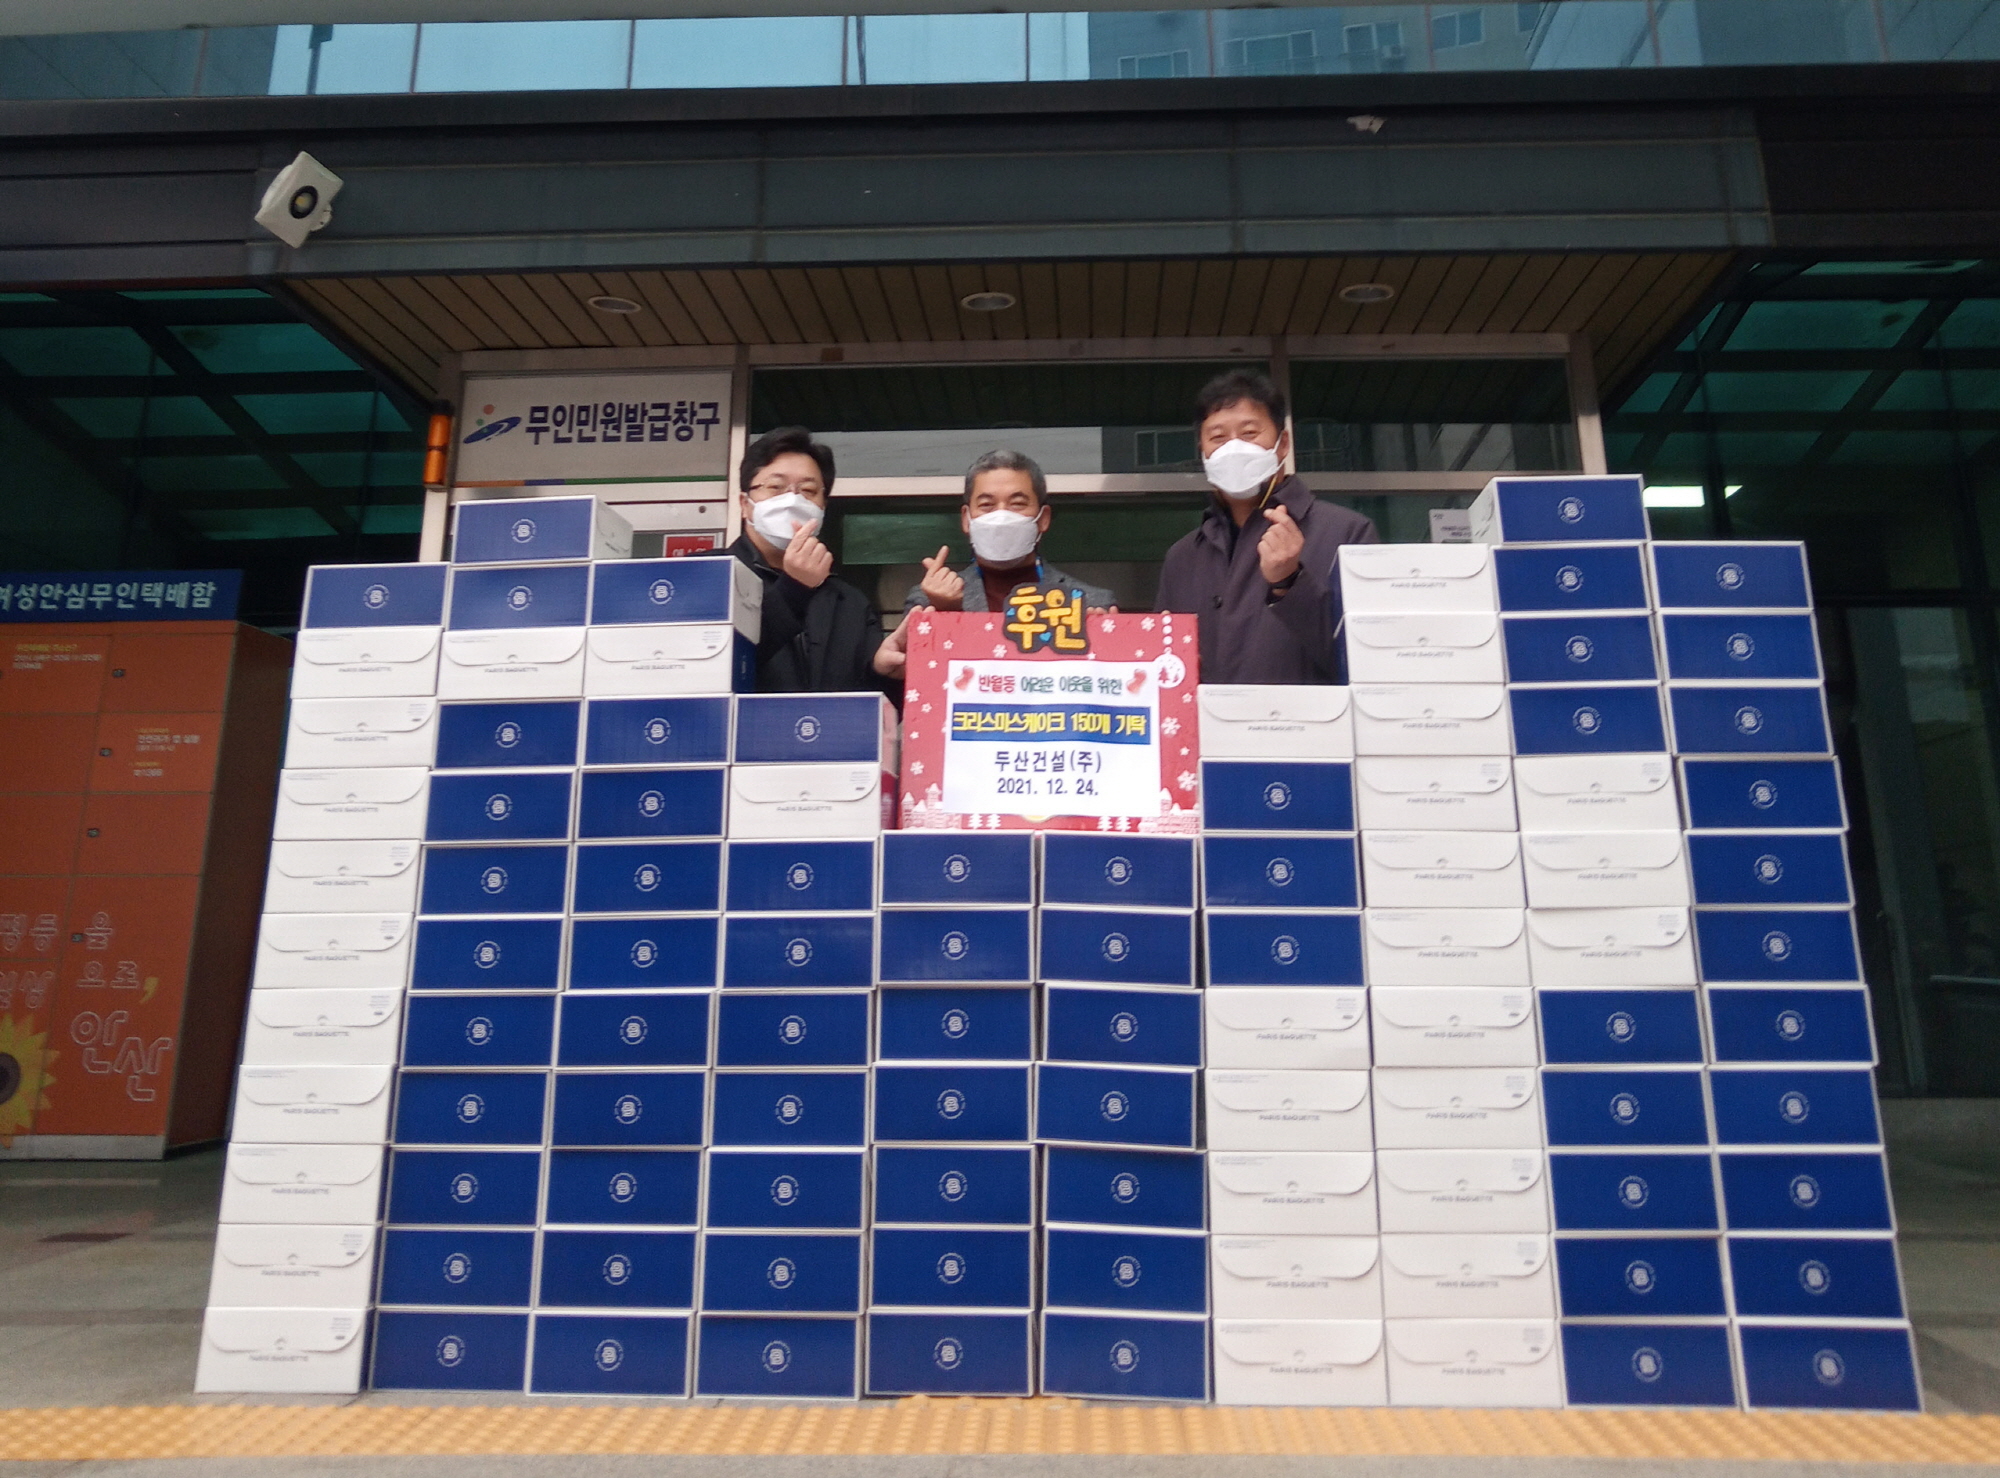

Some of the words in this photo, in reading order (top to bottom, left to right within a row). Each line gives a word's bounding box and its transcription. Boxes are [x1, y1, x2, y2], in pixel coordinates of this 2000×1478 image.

[526, 401, 720, 445] 무인민원발급창구
[1007, 586, 1086, 649] 후원
[979, 675, 1015, 693] 반월동
[1021, 676, 1054, 693] 어려운
[1059, 676, 1092, 693] 이웃을
[1098, 677, 1122, 694] 위한
[952, 711, 1065, 733] 크리스마스케이크
[1071, 712, 1111, 734] 150개
[1115, 714, 1147, 736] 기탁
[994, 750, 1102, 773] 두산건설(주)
[997, 778, 1038, 795] 2021.
[1047, 778, 1068, 795] 12.
[1076, 778, 1099, 796] 24.
